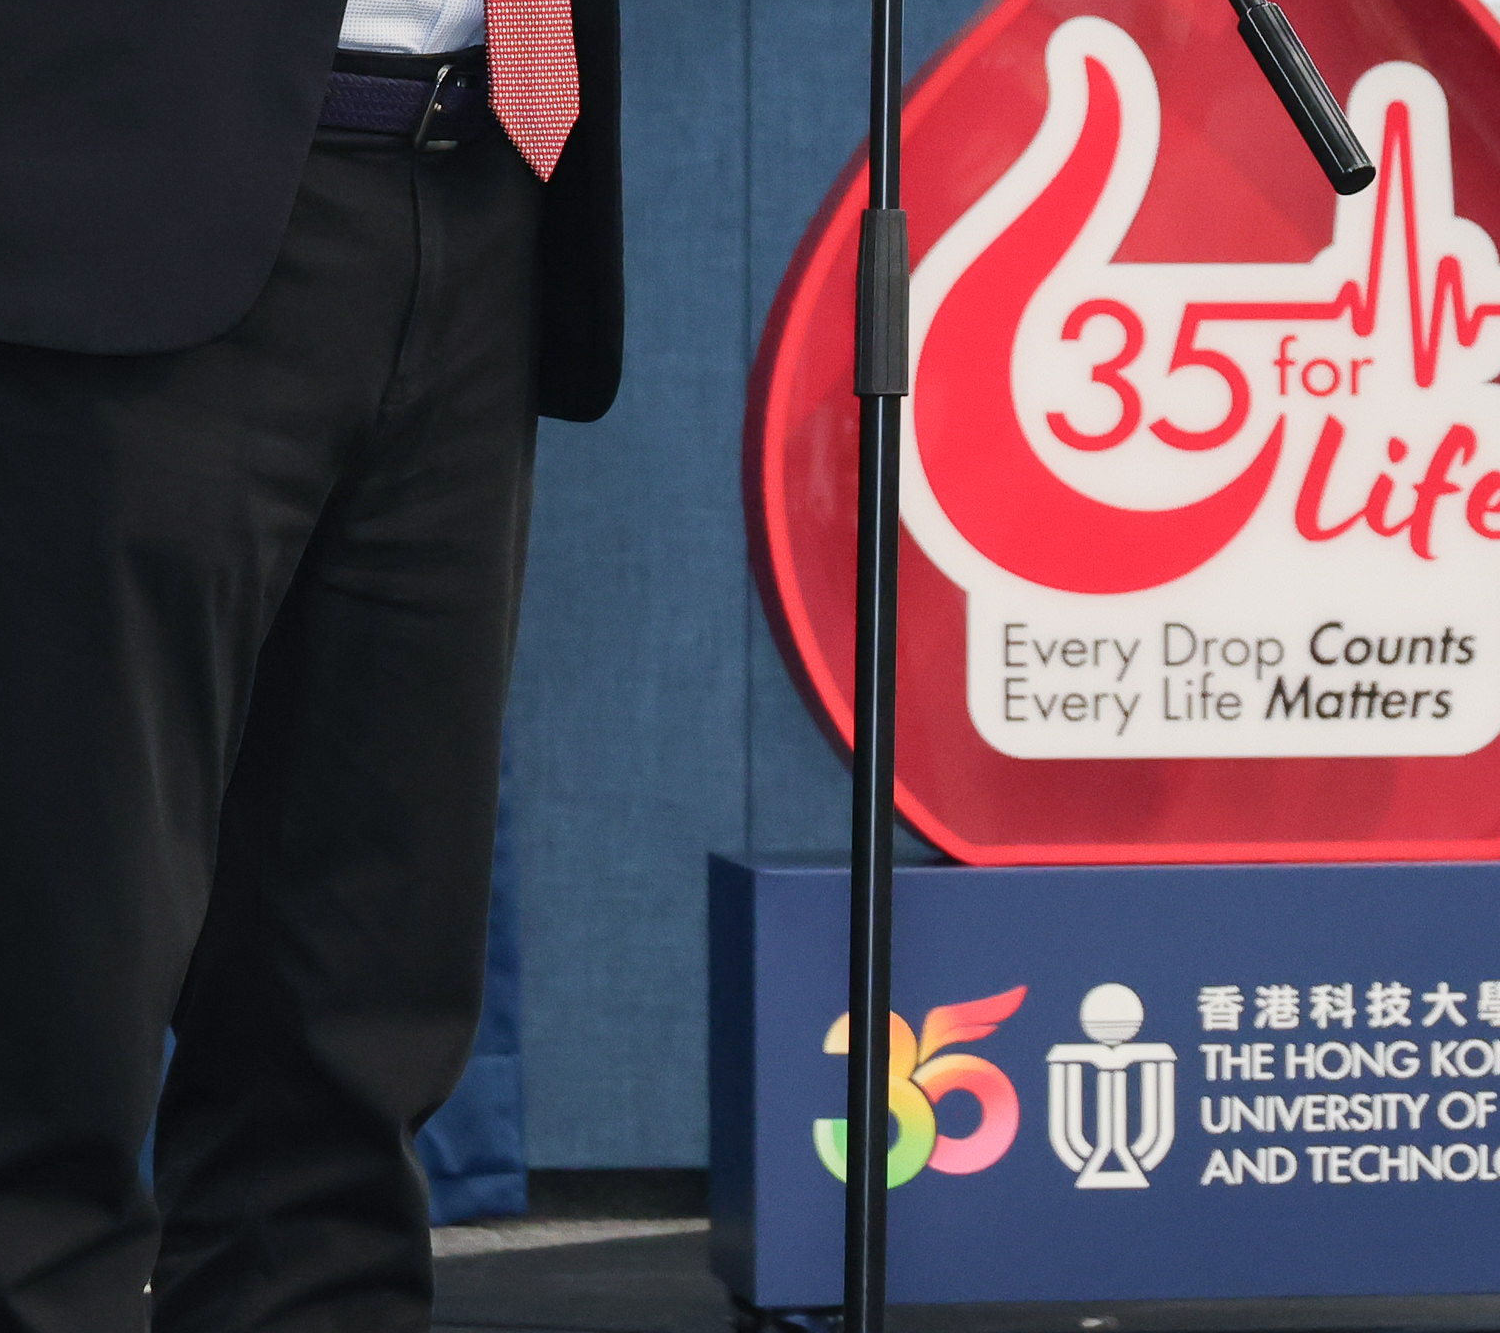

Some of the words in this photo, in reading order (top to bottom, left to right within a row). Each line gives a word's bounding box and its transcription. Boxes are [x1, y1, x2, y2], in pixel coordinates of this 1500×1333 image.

[1047, 298, 1251, 452] 35
[1273, 335, 1375, 397] for
[1004, 622, 1141, 682] Every
[1163, 622, 1285, 681] Drop
[1310, 621, 1476, 666] Counts
[1004, 676, 1141, 736] Every
[1164, 672, 1243, 721] Life
[1265, 674, 1453, 721] Matters
[1199, 1042, 1275, 1082] THE
[1285, 1040, 1421, 1081] HONG
[1199, 1091, 1430, 1134] UNIVERSITY
[1436, 1090, 1498, 1131] OF
[1199, 1146, 1298, 1186] AND
